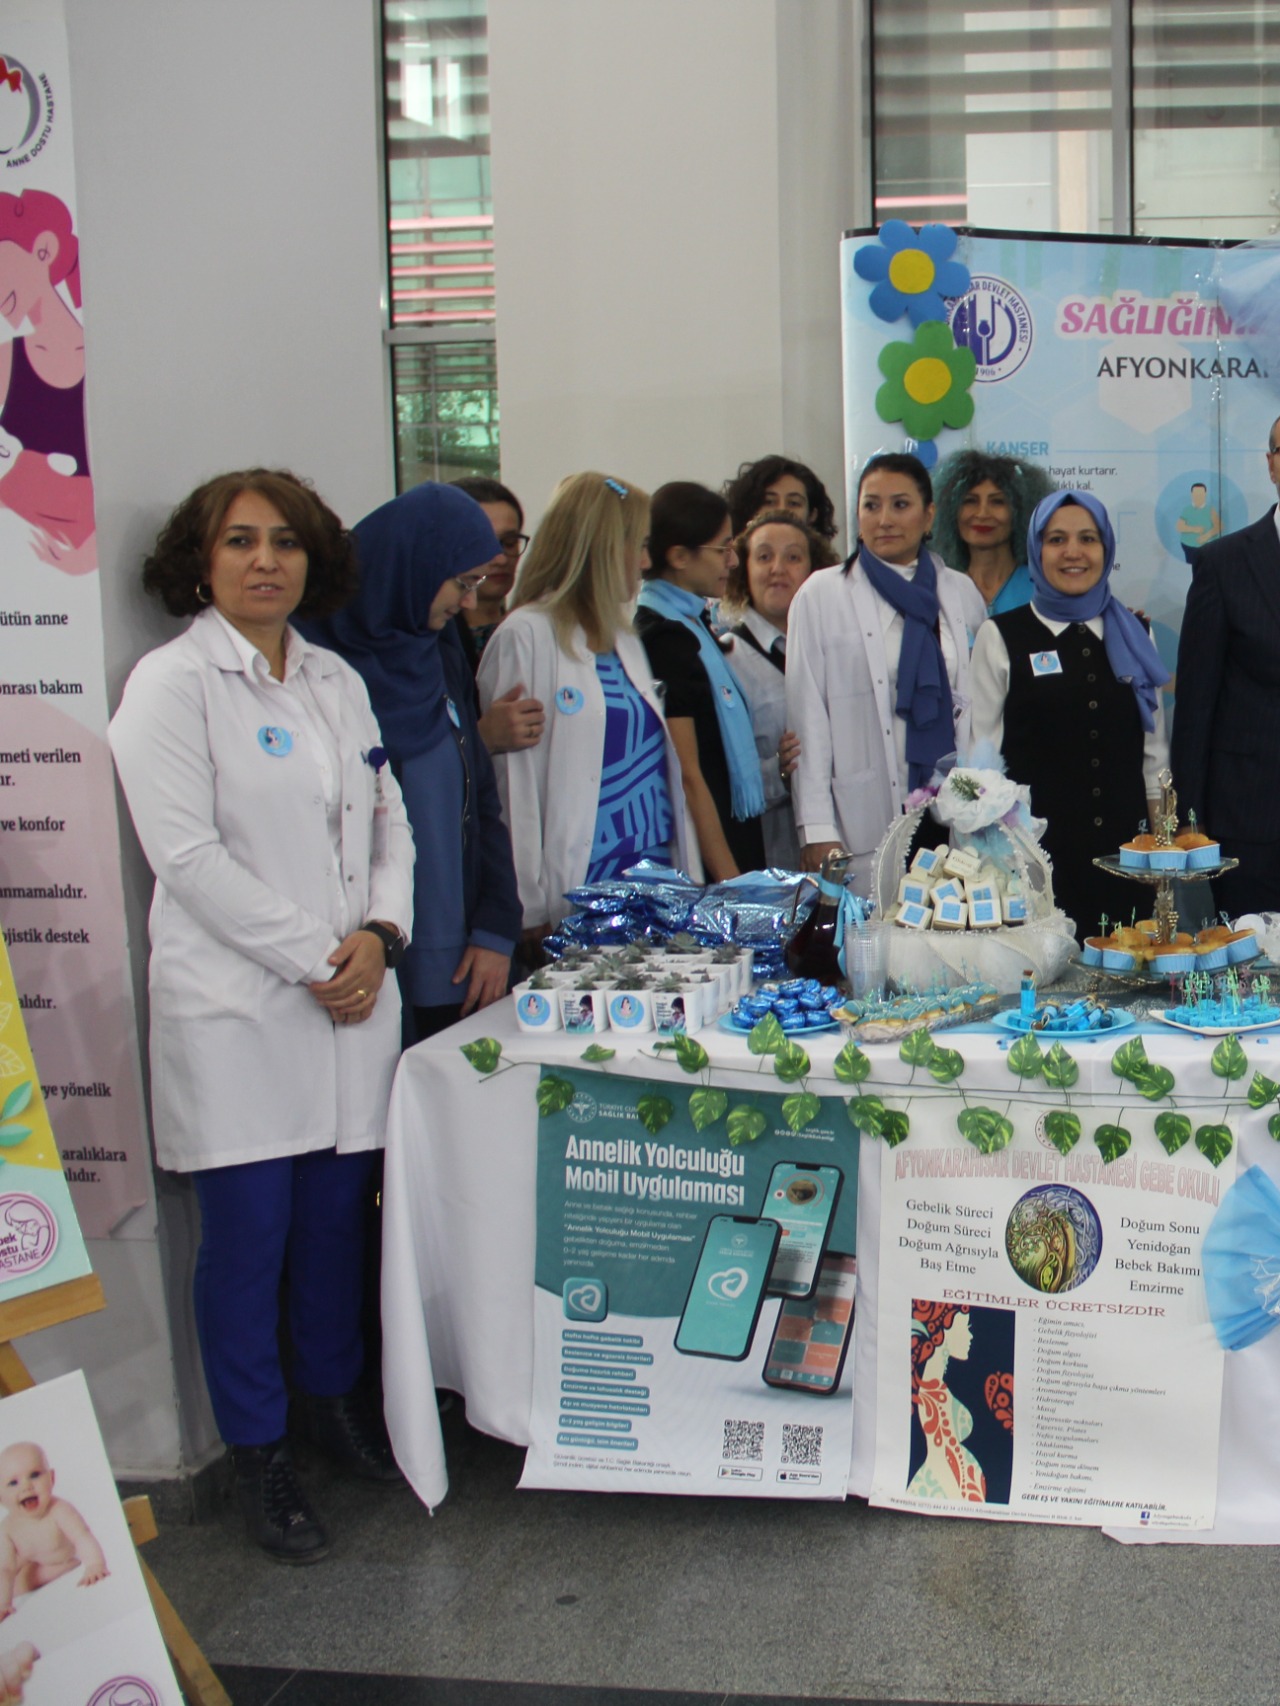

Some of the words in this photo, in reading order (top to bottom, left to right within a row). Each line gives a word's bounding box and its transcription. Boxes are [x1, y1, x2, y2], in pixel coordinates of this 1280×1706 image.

[39, 72, 54, 123] HASTANE
[30, 125, 52, 157] DOSTU
[6, 153, 31, 168] ANNE
[982, 281, 1011, 297] DEVLET
[1061, 297, 1257, 336] SAĞLIĞIN
[1097, 356, 1267, 379] AFYONKARA
[986, 441, 1049, 456] KANSER
[1049, 465, 1076, 478] hayat
[1078, 465, 1118, 476] kurtarır.
[35, 614, 68, 626] anne
[39, 679, 83, 695] bakım
[33, 748, 81, 763] verilen
[0, 819, 16, 832] ve
[18, 816, 65, 832] konfor
[45, 928, 90, 943] destek
[61, 1082, 112, 1100] yönelik
[599, 1111, 624, 1119] SAĞLIK
[62, 1146, 127, 1162] aralıklara
[565, 1135, 641, 1166] Annelik
[645, 1142, 745, 1178] Yolculuğu
[565, 1165, 619, 1195] Mobil
[622, 1171, 745, 1207] Uygulaması
[1012, 1150, 1062, 1181] DEVLET
[1065, 1152, 1137, 1189] HASTANESİ
[1140, 1160, 1175, 1195] GEBE
[1177, 1167, 1220, 1207] OKULU
[906, 1199, 951, 1215] Gebelik
[955, 1205, 993, 1219] Süreci
[595, 1227, 629, 1236] Yolculuğu
[630, 1230, 650, 1238] Mobil
[907, 1218, 950, 1234] Doğum
[954, 1224, 991, 1238] Süreci
[1120, 1217, 1165, 1233] Doğum
[1169, 1221, 1200, 1234] Sonu
[899, 1236, 942, 1252] Doğum
[945, 1242, 999, 1260] Ağrısıyla
[1128, 1238, 1191, 1256] Yenidoğan
[920, 1257, 942, 1272] Baş
[946, 1260, 976, 1274] Etme
[1115, 1258, 1152, 1272] Bebek
[1157, 1261, 1200, 1276] Bakımı
[1130, 1280, 1184, 1295] Emzirme
[942, 1288, 1039, 1308] EĞİTİMLER
[1046, 1299, 1166, 1317] ÜCRETSİZDİR
[1037, 1347, 1061, 1356] Doğum
[1021, 1493, 1039, 1501] GEBE
[1040, 1494, 1048, 1503] EŞ
[1061, 1497, 1083, 1505] YAKINI
[1084, 1498, 1124, 1508] EĞİTİMLERE
